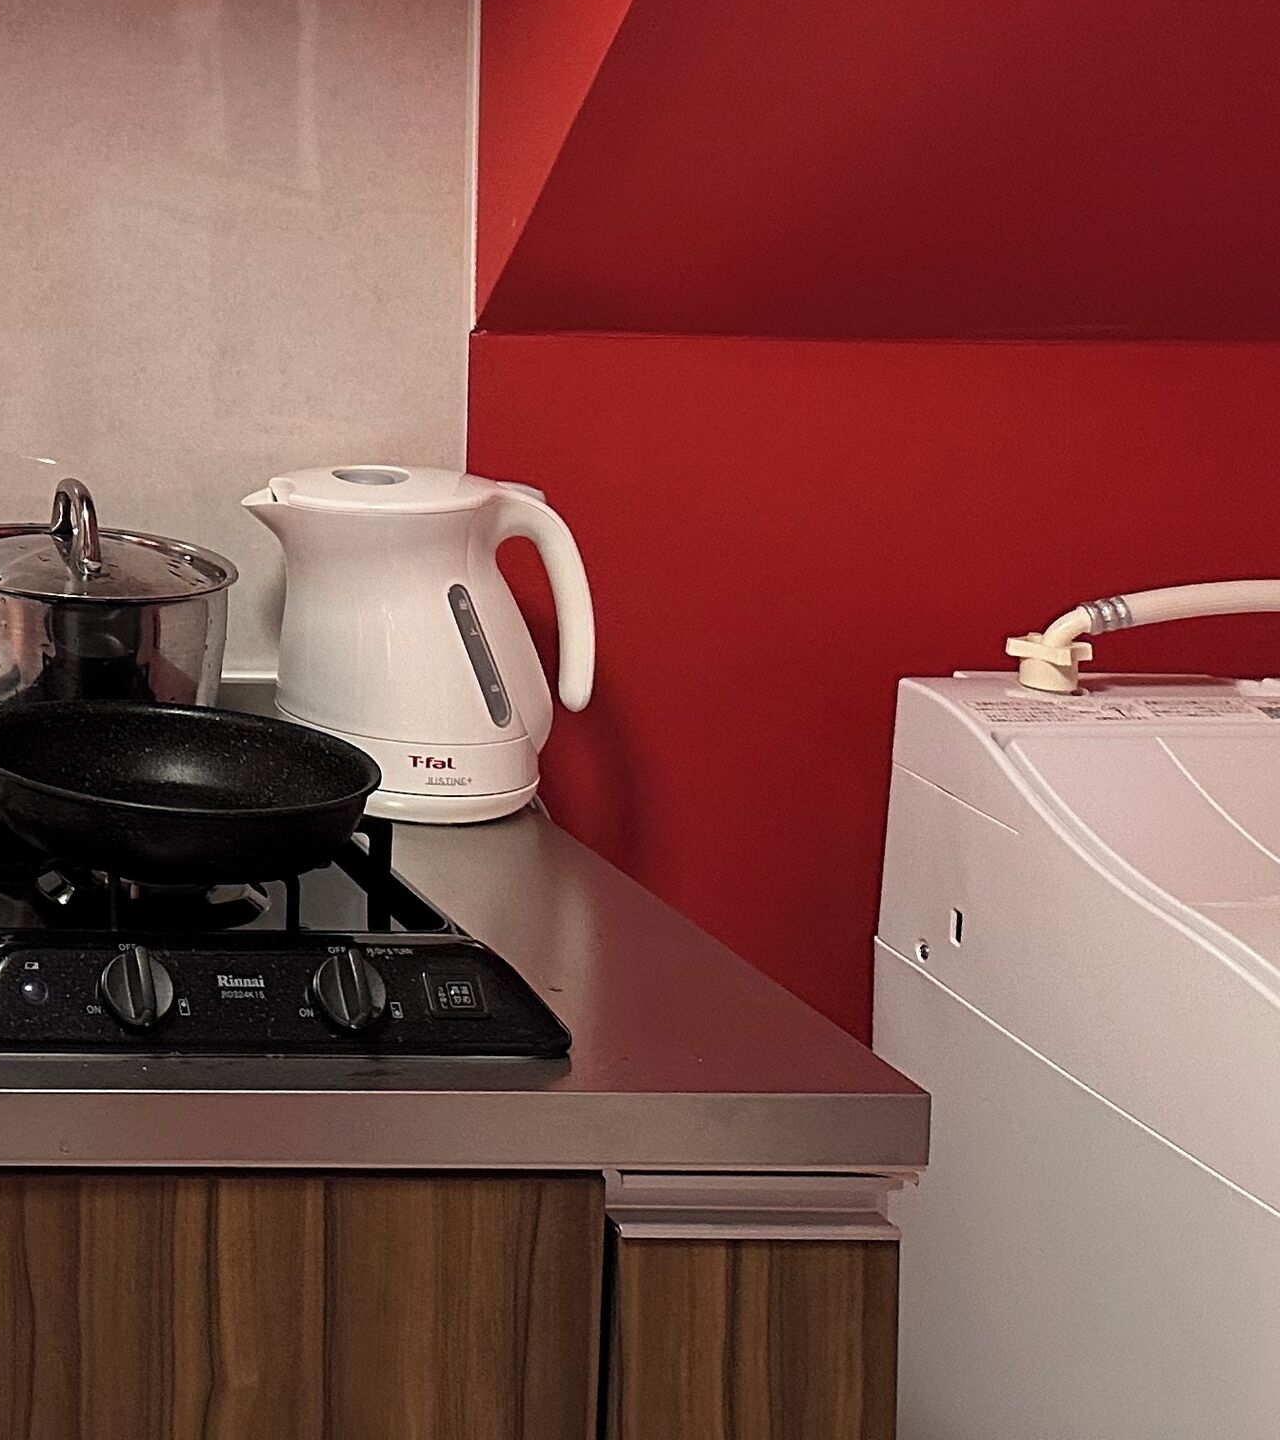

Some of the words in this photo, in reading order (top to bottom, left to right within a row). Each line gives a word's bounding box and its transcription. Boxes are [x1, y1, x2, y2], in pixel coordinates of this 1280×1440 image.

[407, 754, 457, 770] T-fal
[328, 946, 346, 954] OFF
[217, 974, 266, 988] Rinnai
[86, 1004, 102, 1014] ON
[298, 1007, 315, 1017] ON
